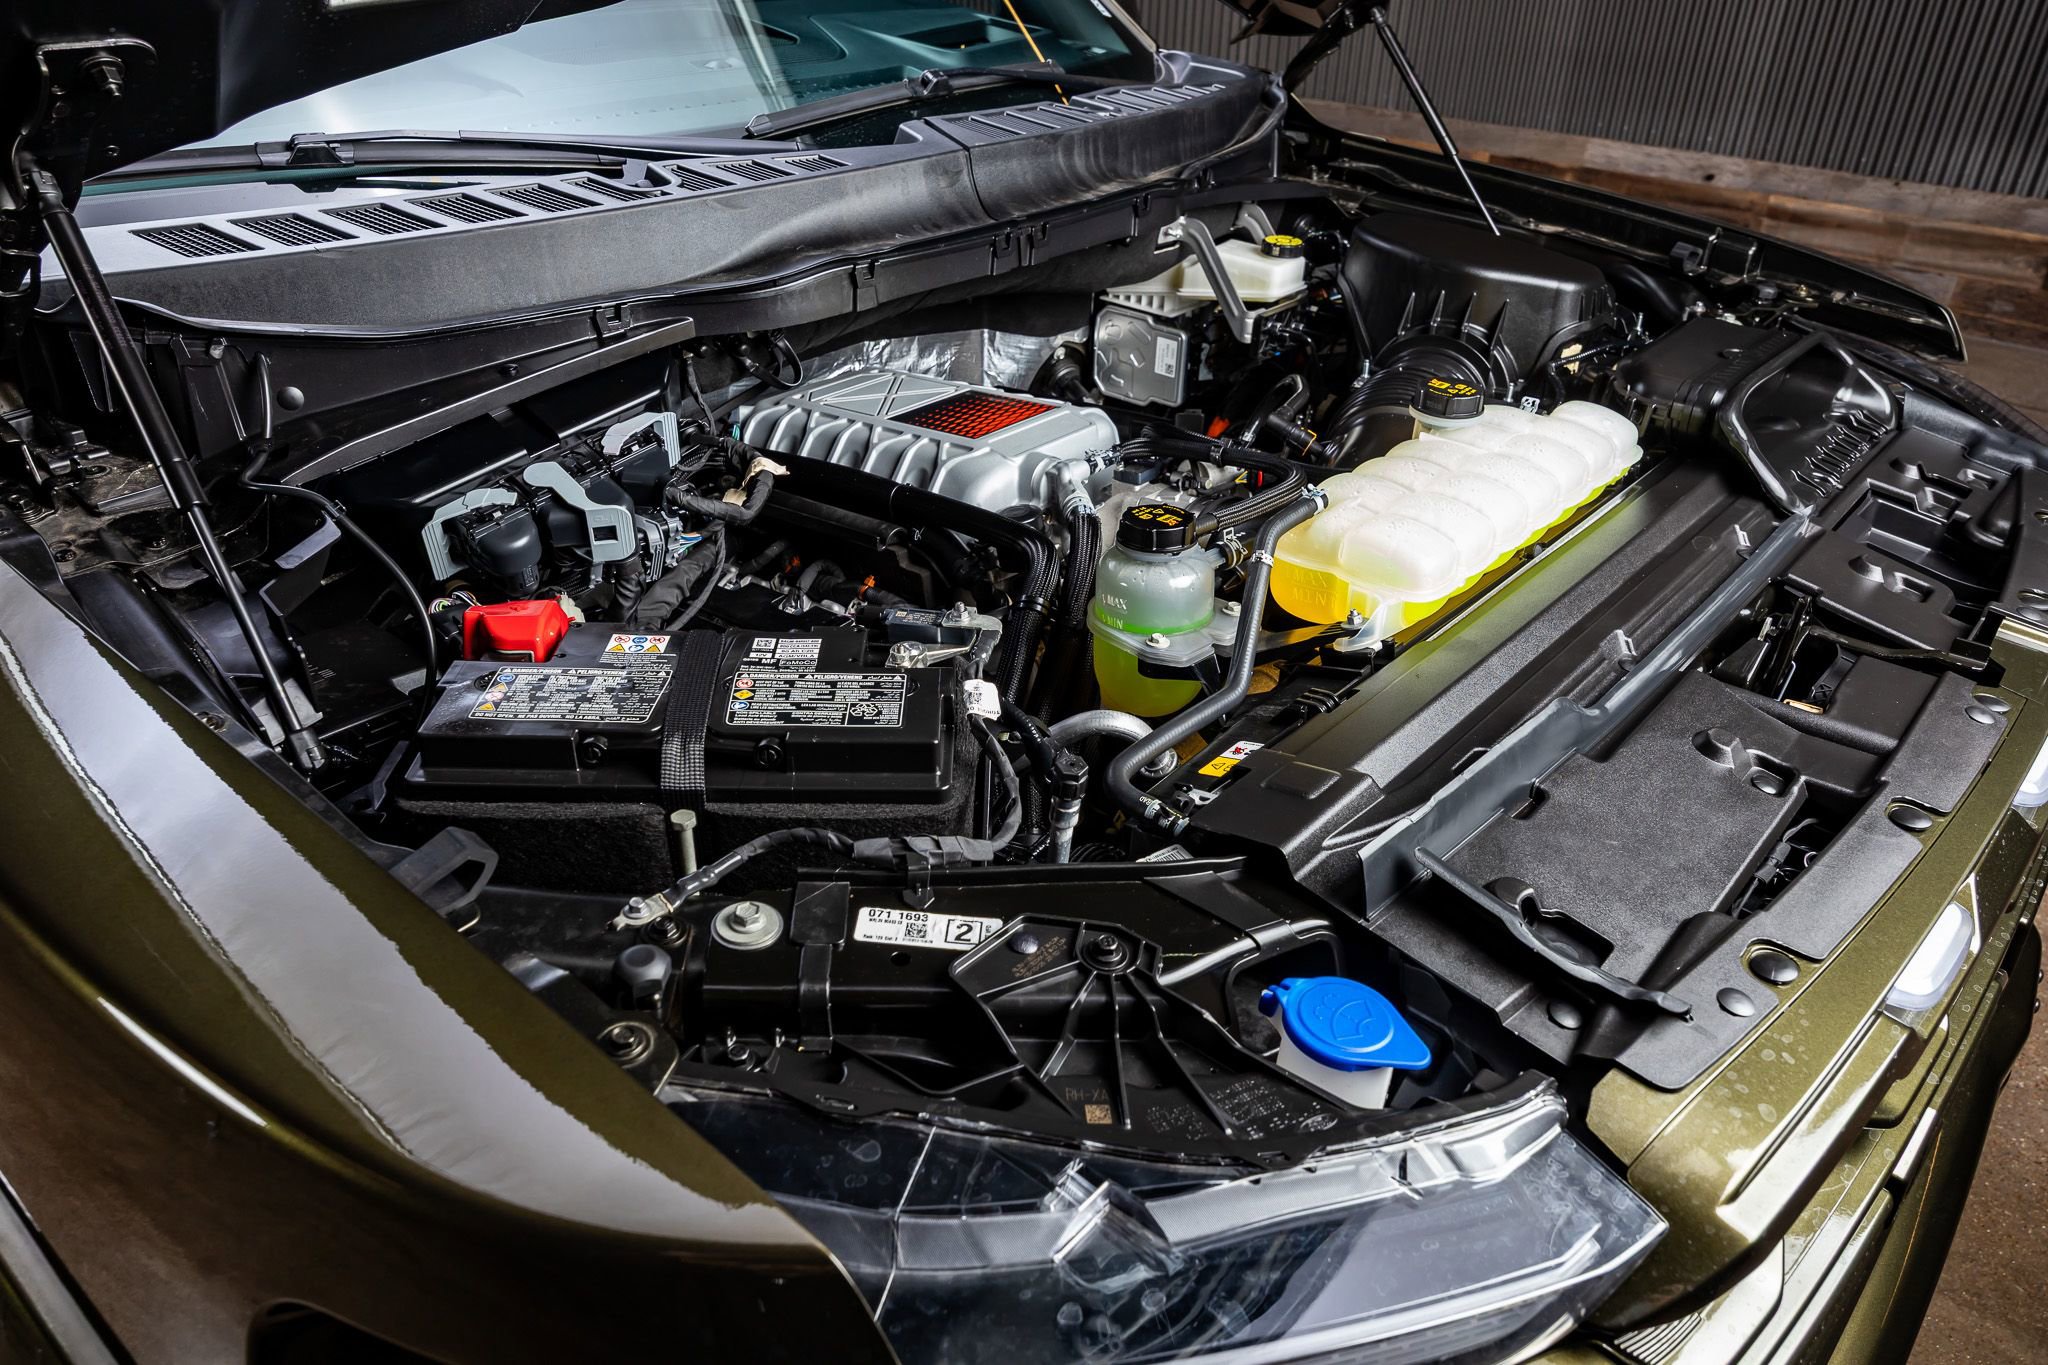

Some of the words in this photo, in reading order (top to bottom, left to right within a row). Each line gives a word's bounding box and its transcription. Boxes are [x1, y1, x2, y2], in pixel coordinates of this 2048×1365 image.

[1107, 594, 1128, 610] MAX
[1107, 615, 1123, 630] MIN
[868, 908, 892, 918] 071
[899, 912, 929, 922] 1693
[954, 923, 974, 942] 2
